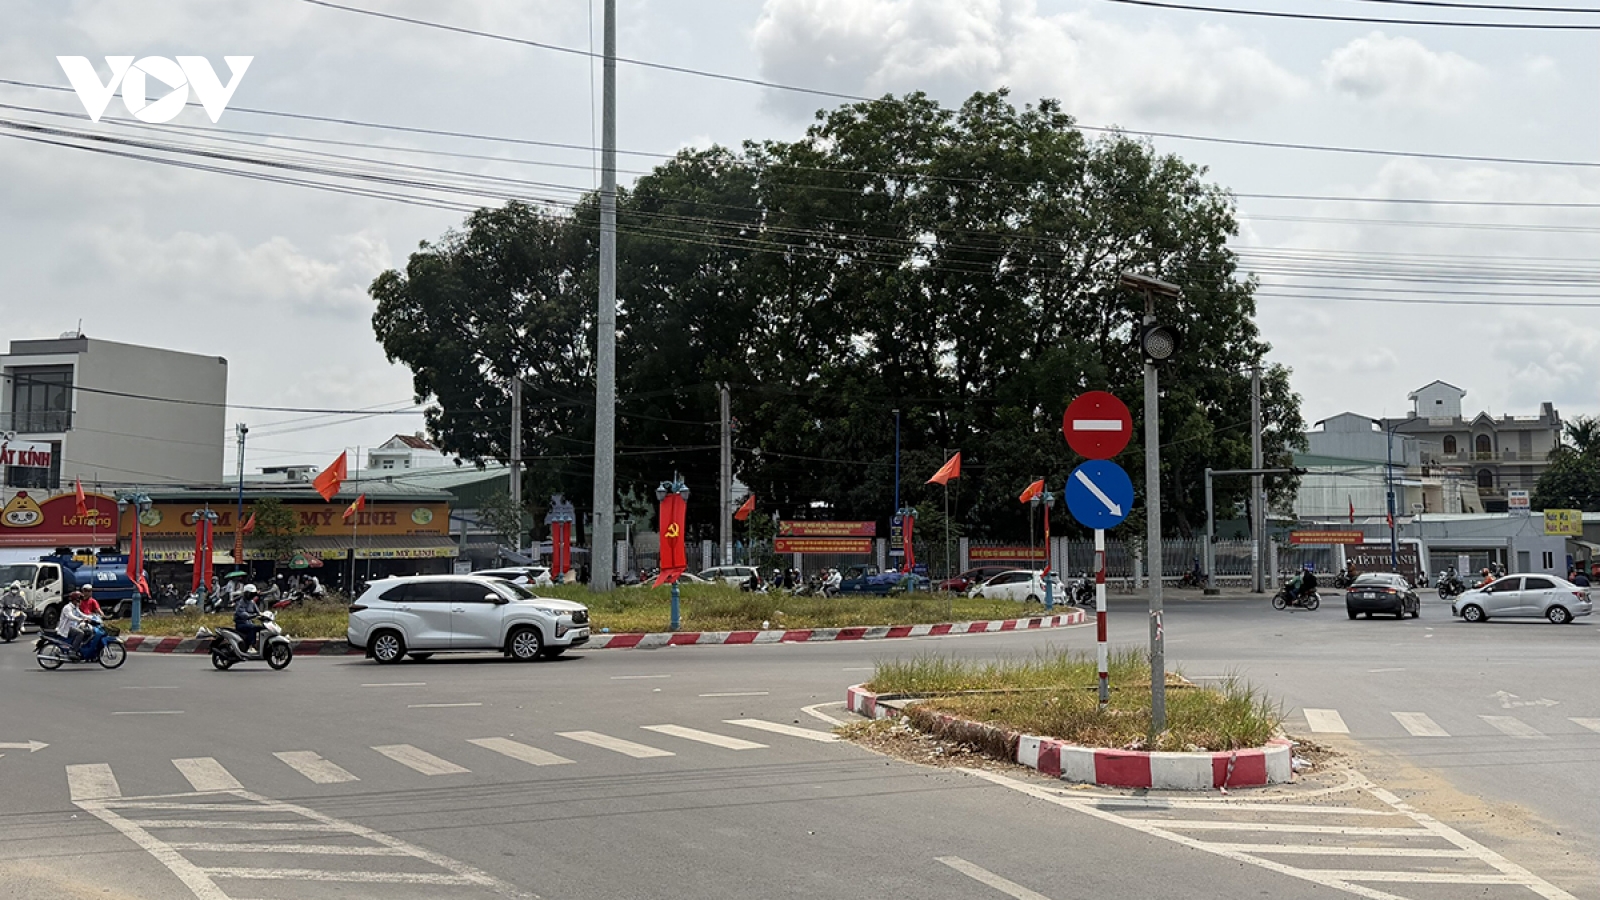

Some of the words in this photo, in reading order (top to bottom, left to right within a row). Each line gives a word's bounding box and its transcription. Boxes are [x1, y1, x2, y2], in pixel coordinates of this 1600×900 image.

[18, 445, 51, 467] KÍNH
[181, 511, 232, 527] CM
[300, 508, 336, 526] MỸ
[344, 511, 397, 526] LINH
